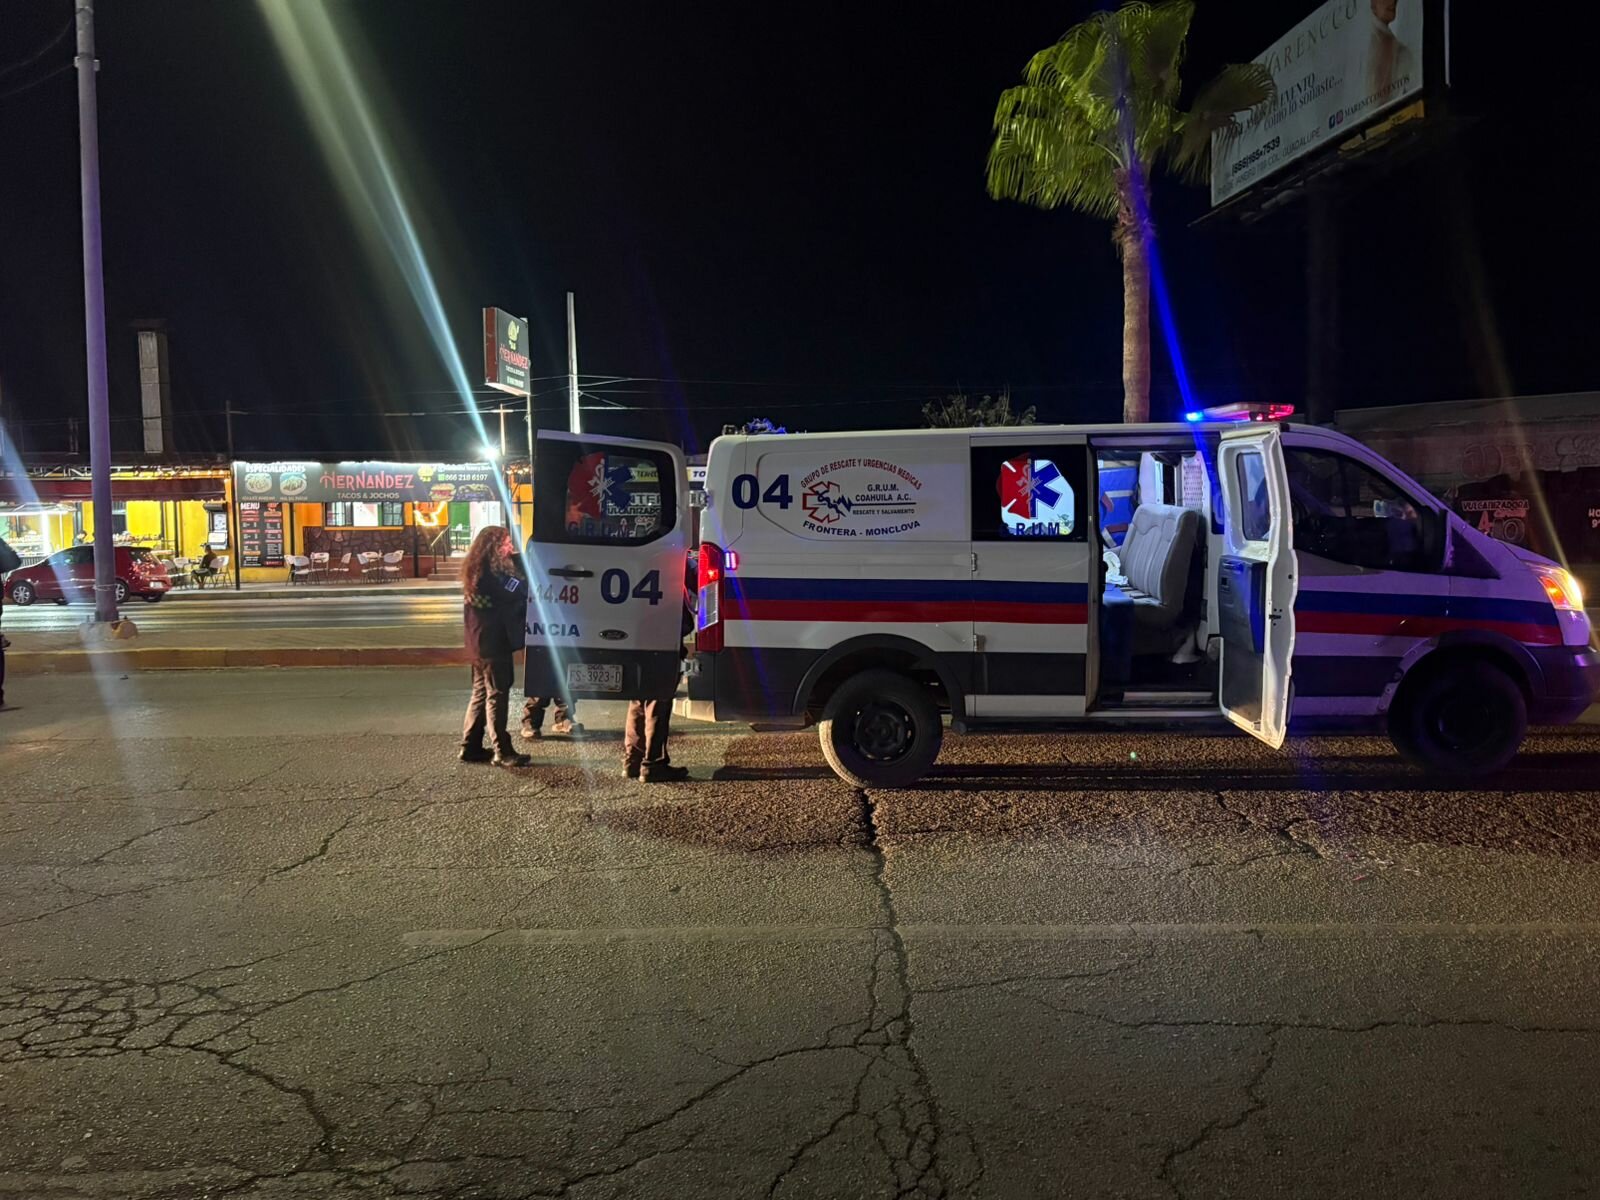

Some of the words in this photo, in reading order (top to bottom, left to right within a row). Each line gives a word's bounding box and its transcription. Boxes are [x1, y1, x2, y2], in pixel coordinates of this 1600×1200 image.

[245, 464, 306, 473] ESPECIALIDADES
[800, 470, 820, 488] GRUPO
[820, 465, 829, 475] DE
[830, 459, 857, 472] RESCATE
[857, 459, 862, 467] Y
[863, 459, 897, 473] URGENCIAS
[897, 468, 923, 490] MEDICAS
[320, 471, 415, 490] HERNANDEZ
[867, 484, 899, 492] G.R.U.M.
[337, 492, 361, 500] TACOS
[369, 492, 399, 500] JOCHOS
[732, 474, 793, 509] 04
[855, 494, 893, 502] COAHUILA
[803, 520, 857, 537] FRONTERA
[866, 520, 920, 537] MONCLOVA
[601, 568, 663, 606] 04
